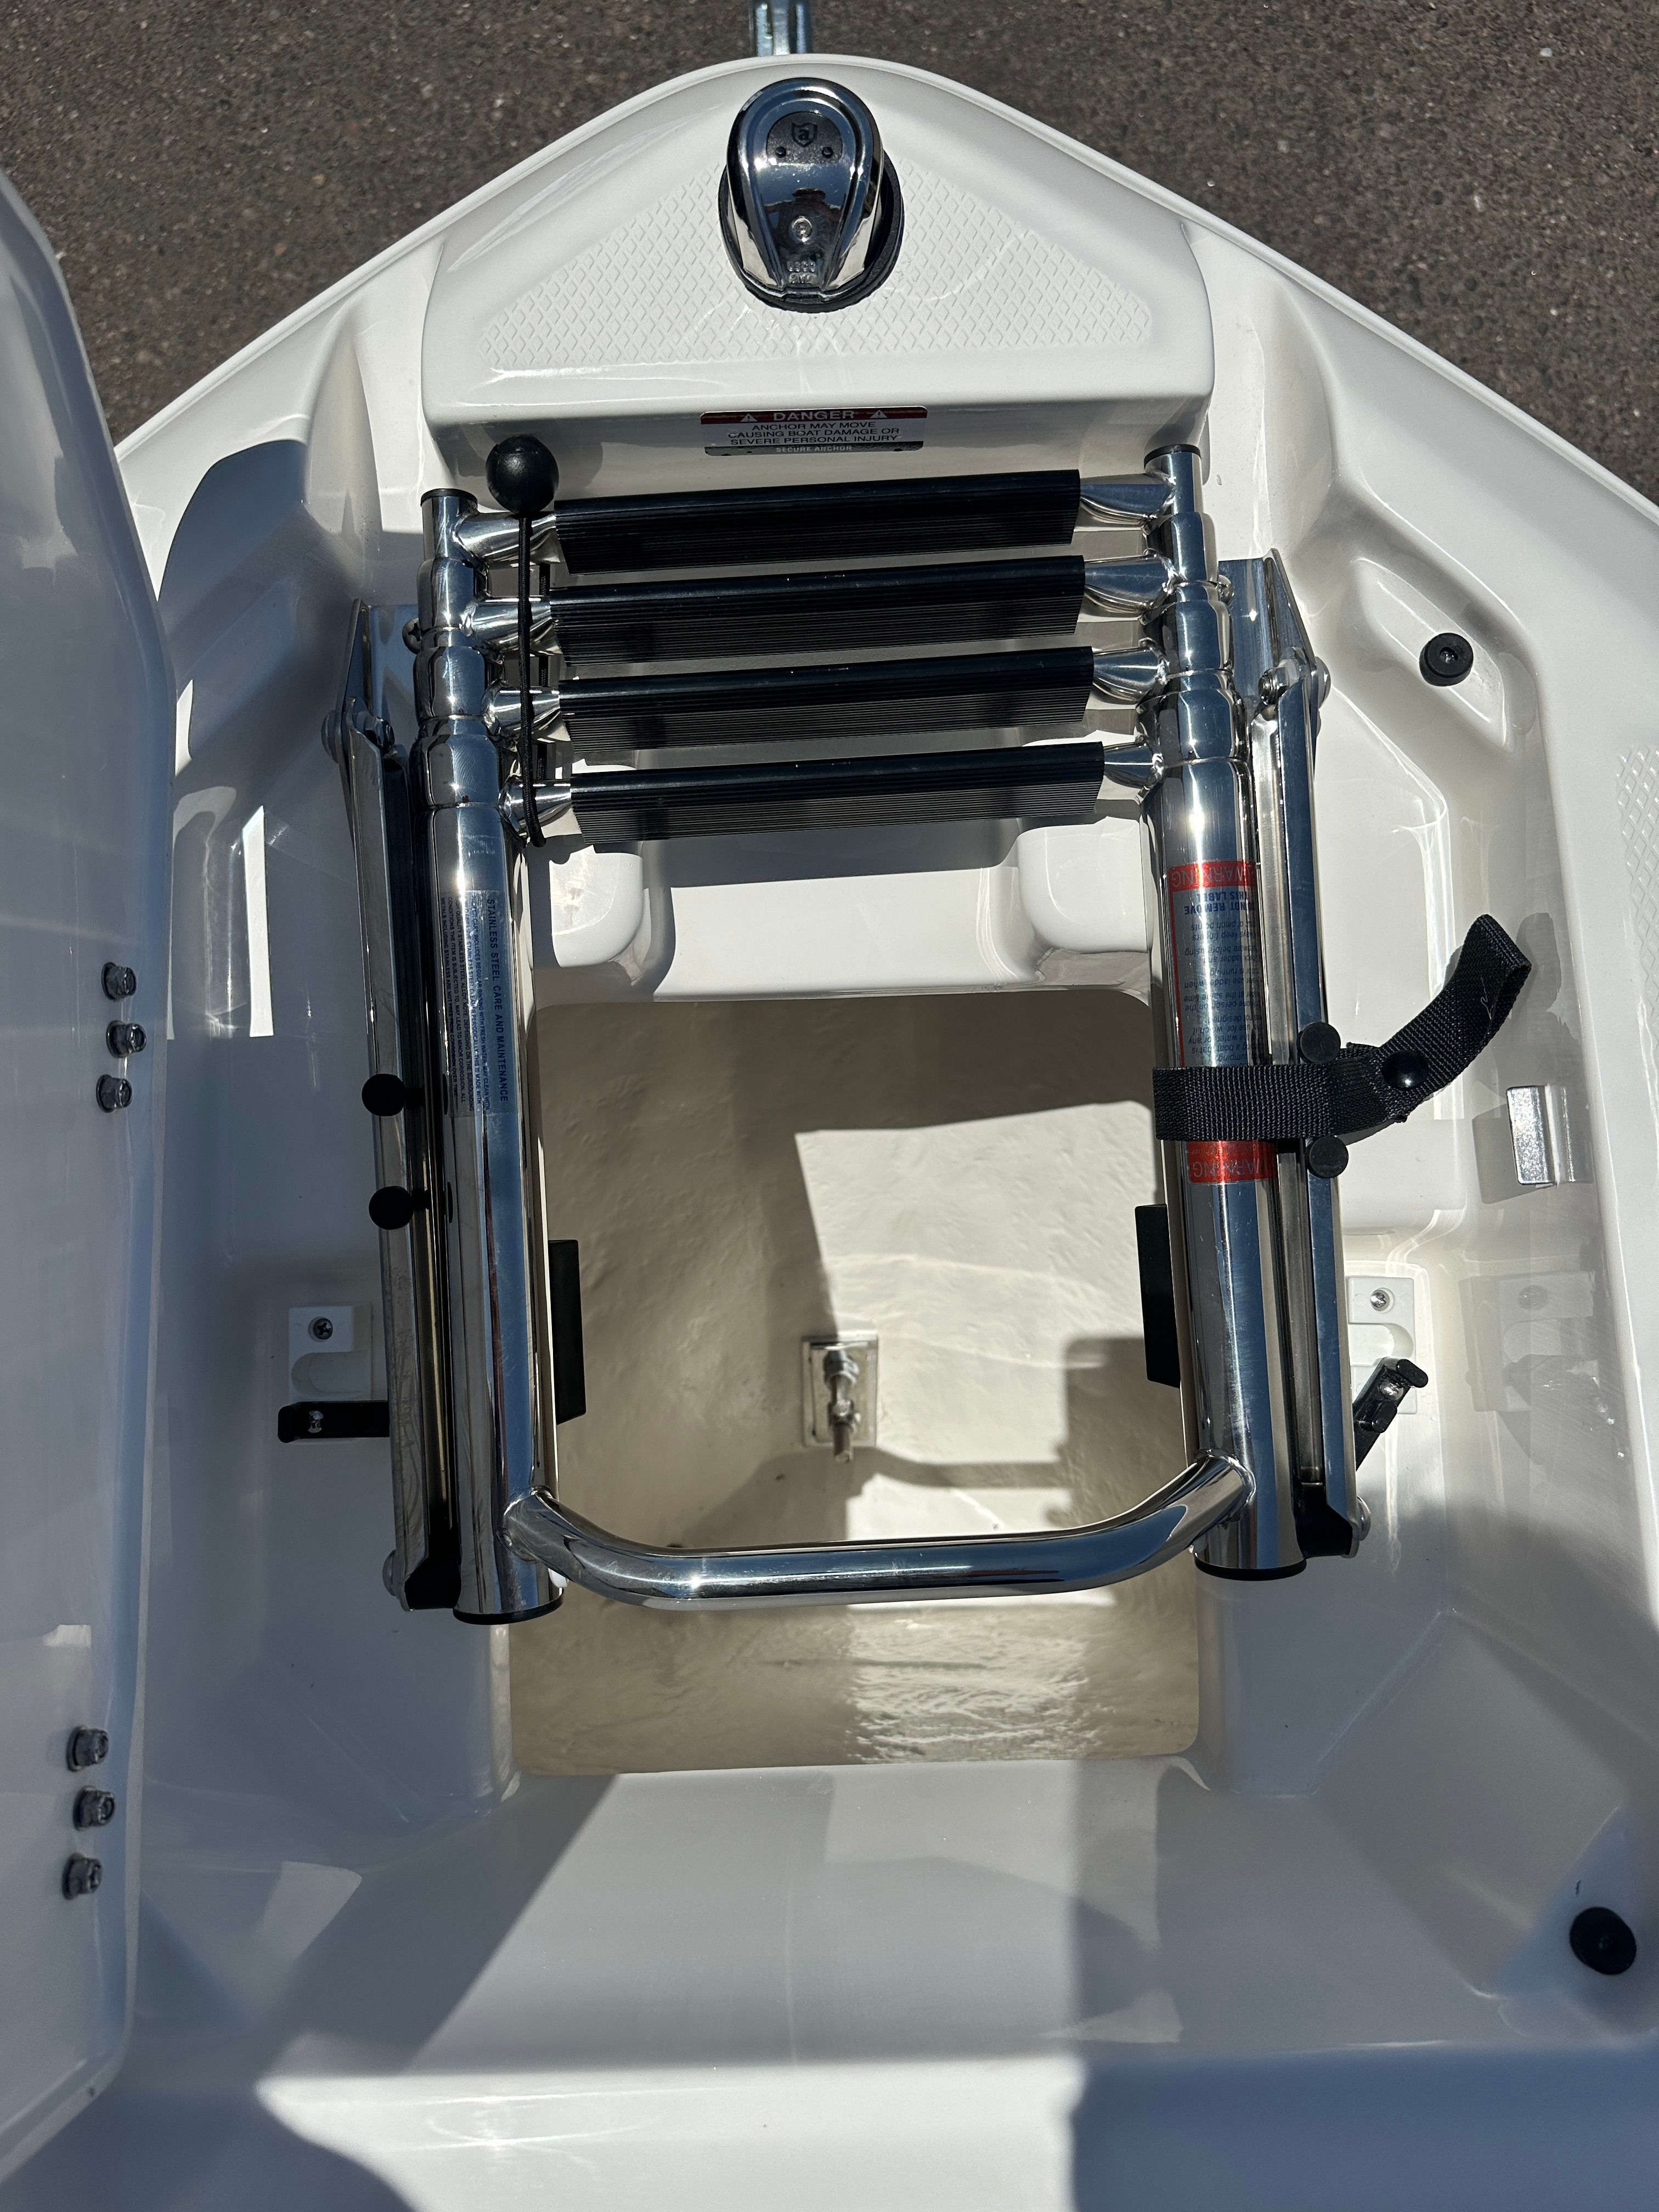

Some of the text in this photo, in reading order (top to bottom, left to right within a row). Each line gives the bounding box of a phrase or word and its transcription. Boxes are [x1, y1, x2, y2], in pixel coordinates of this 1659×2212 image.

[774, 410, 855, 421] DANGER
[1172, 865, 1244, 888] WARNING
[1184, 902, 1225, 915] REMOVE
[1230, 902, 1245, 911] NOT
[1190, 921, 1214, 930] ponts
[1217, 921, 1236, 930] pinch
[1221, 930, 1238, 939] keep
[1185, 948, 1204, 957] using
[1184, 981, 1204, 990] when
[487, 899, 508, 1102] STAINLESS STEEL CARE AND MAINTENANCE
[1188, 1036, 1201, 1045] any
[1218, 1045, 1233, 1053] boat
